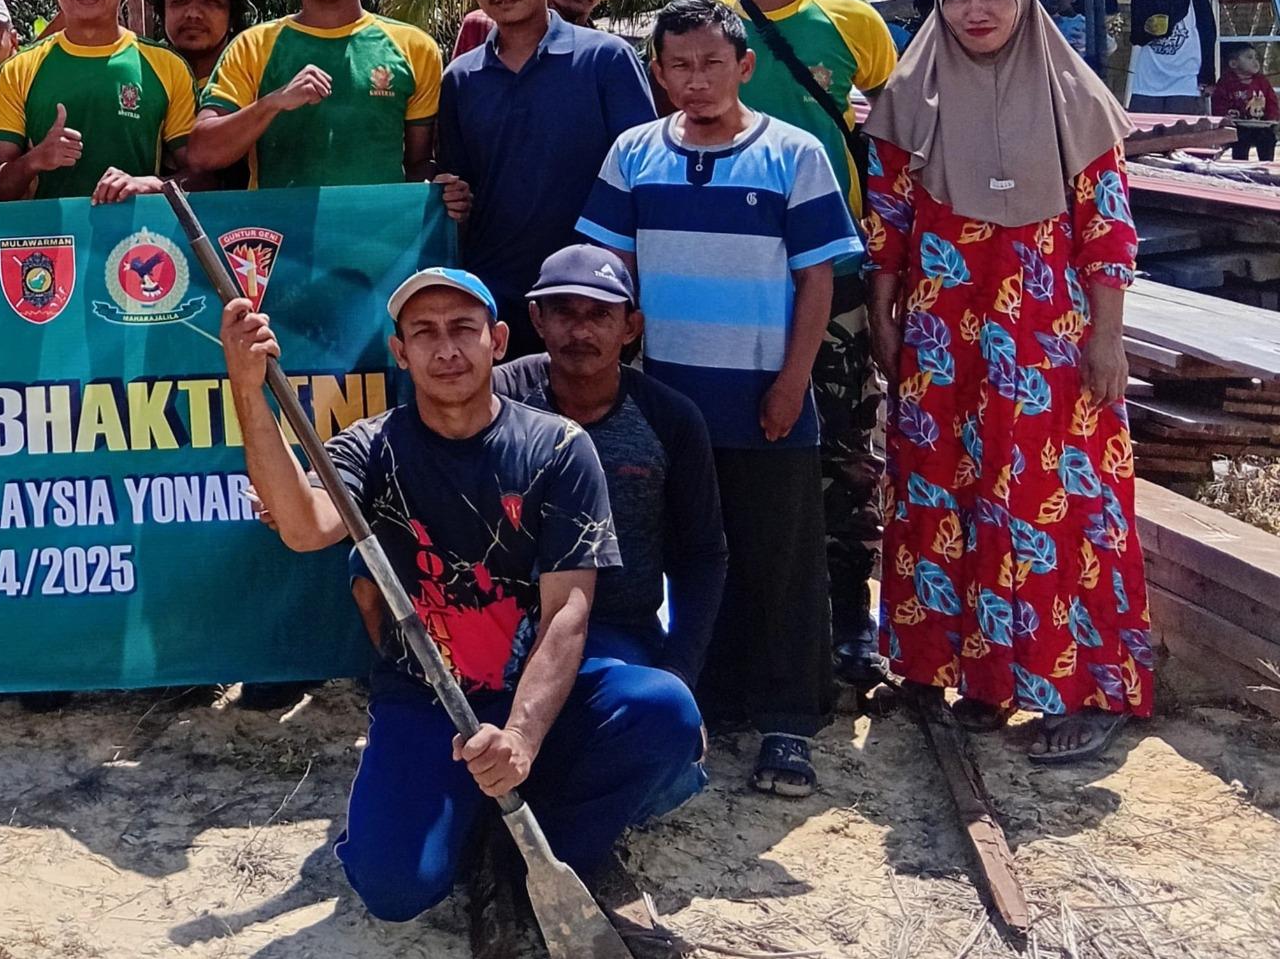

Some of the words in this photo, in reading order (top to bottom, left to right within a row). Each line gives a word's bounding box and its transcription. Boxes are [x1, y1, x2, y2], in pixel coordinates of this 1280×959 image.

[1, 238, 71, 248] MULAWARMAN
[223, 230, 257, 243] GUNTUR
[124, 474, 260, 525] YONAR
